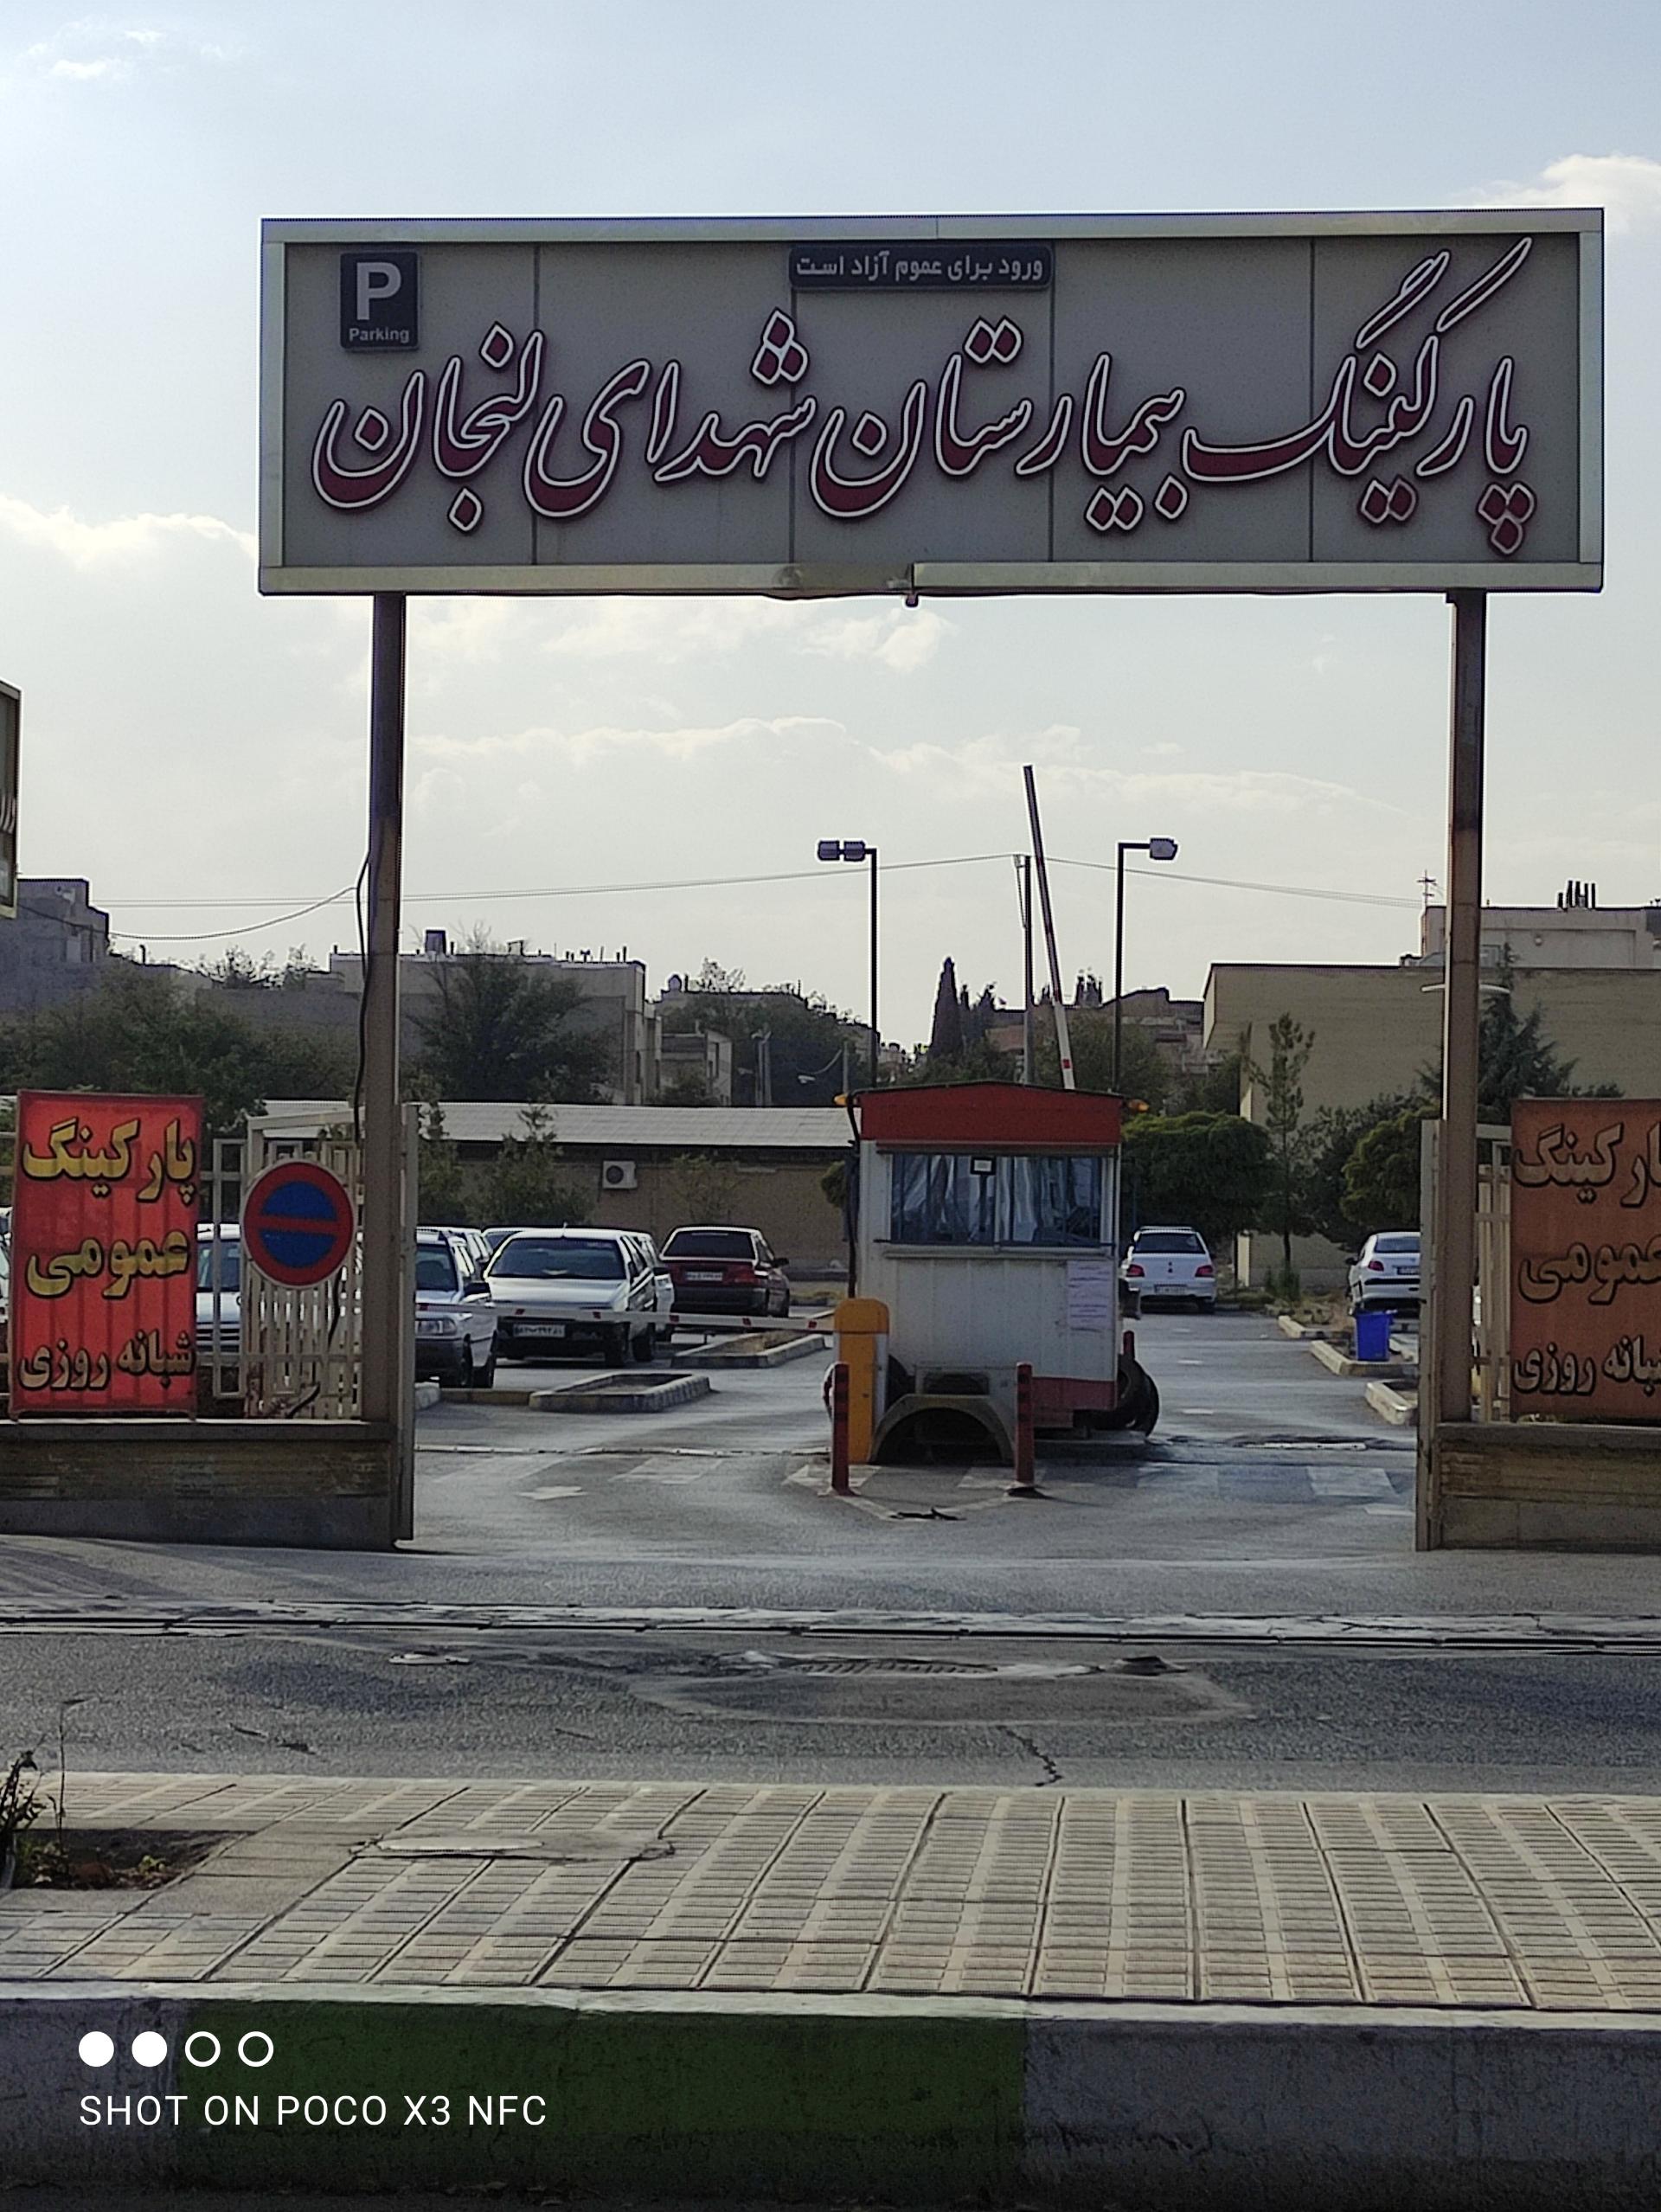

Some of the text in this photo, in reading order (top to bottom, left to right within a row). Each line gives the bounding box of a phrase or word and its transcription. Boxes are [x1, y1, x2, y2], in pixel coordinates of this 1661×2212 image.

[357, 262, 401, 320] P
[796, 250, 1043, 282] ورود برای عموم آزاد است
[349, 328, 410, 343] Parking
[312, 237, 1536, 554] پارکینگ بیمارستان شهدای لنجان
[26, 1230, 191, 1297] عمومی
[18, 1329, 196, 1390] شبانه روزی
[1512, 1342, 1597, 1396] روزی
